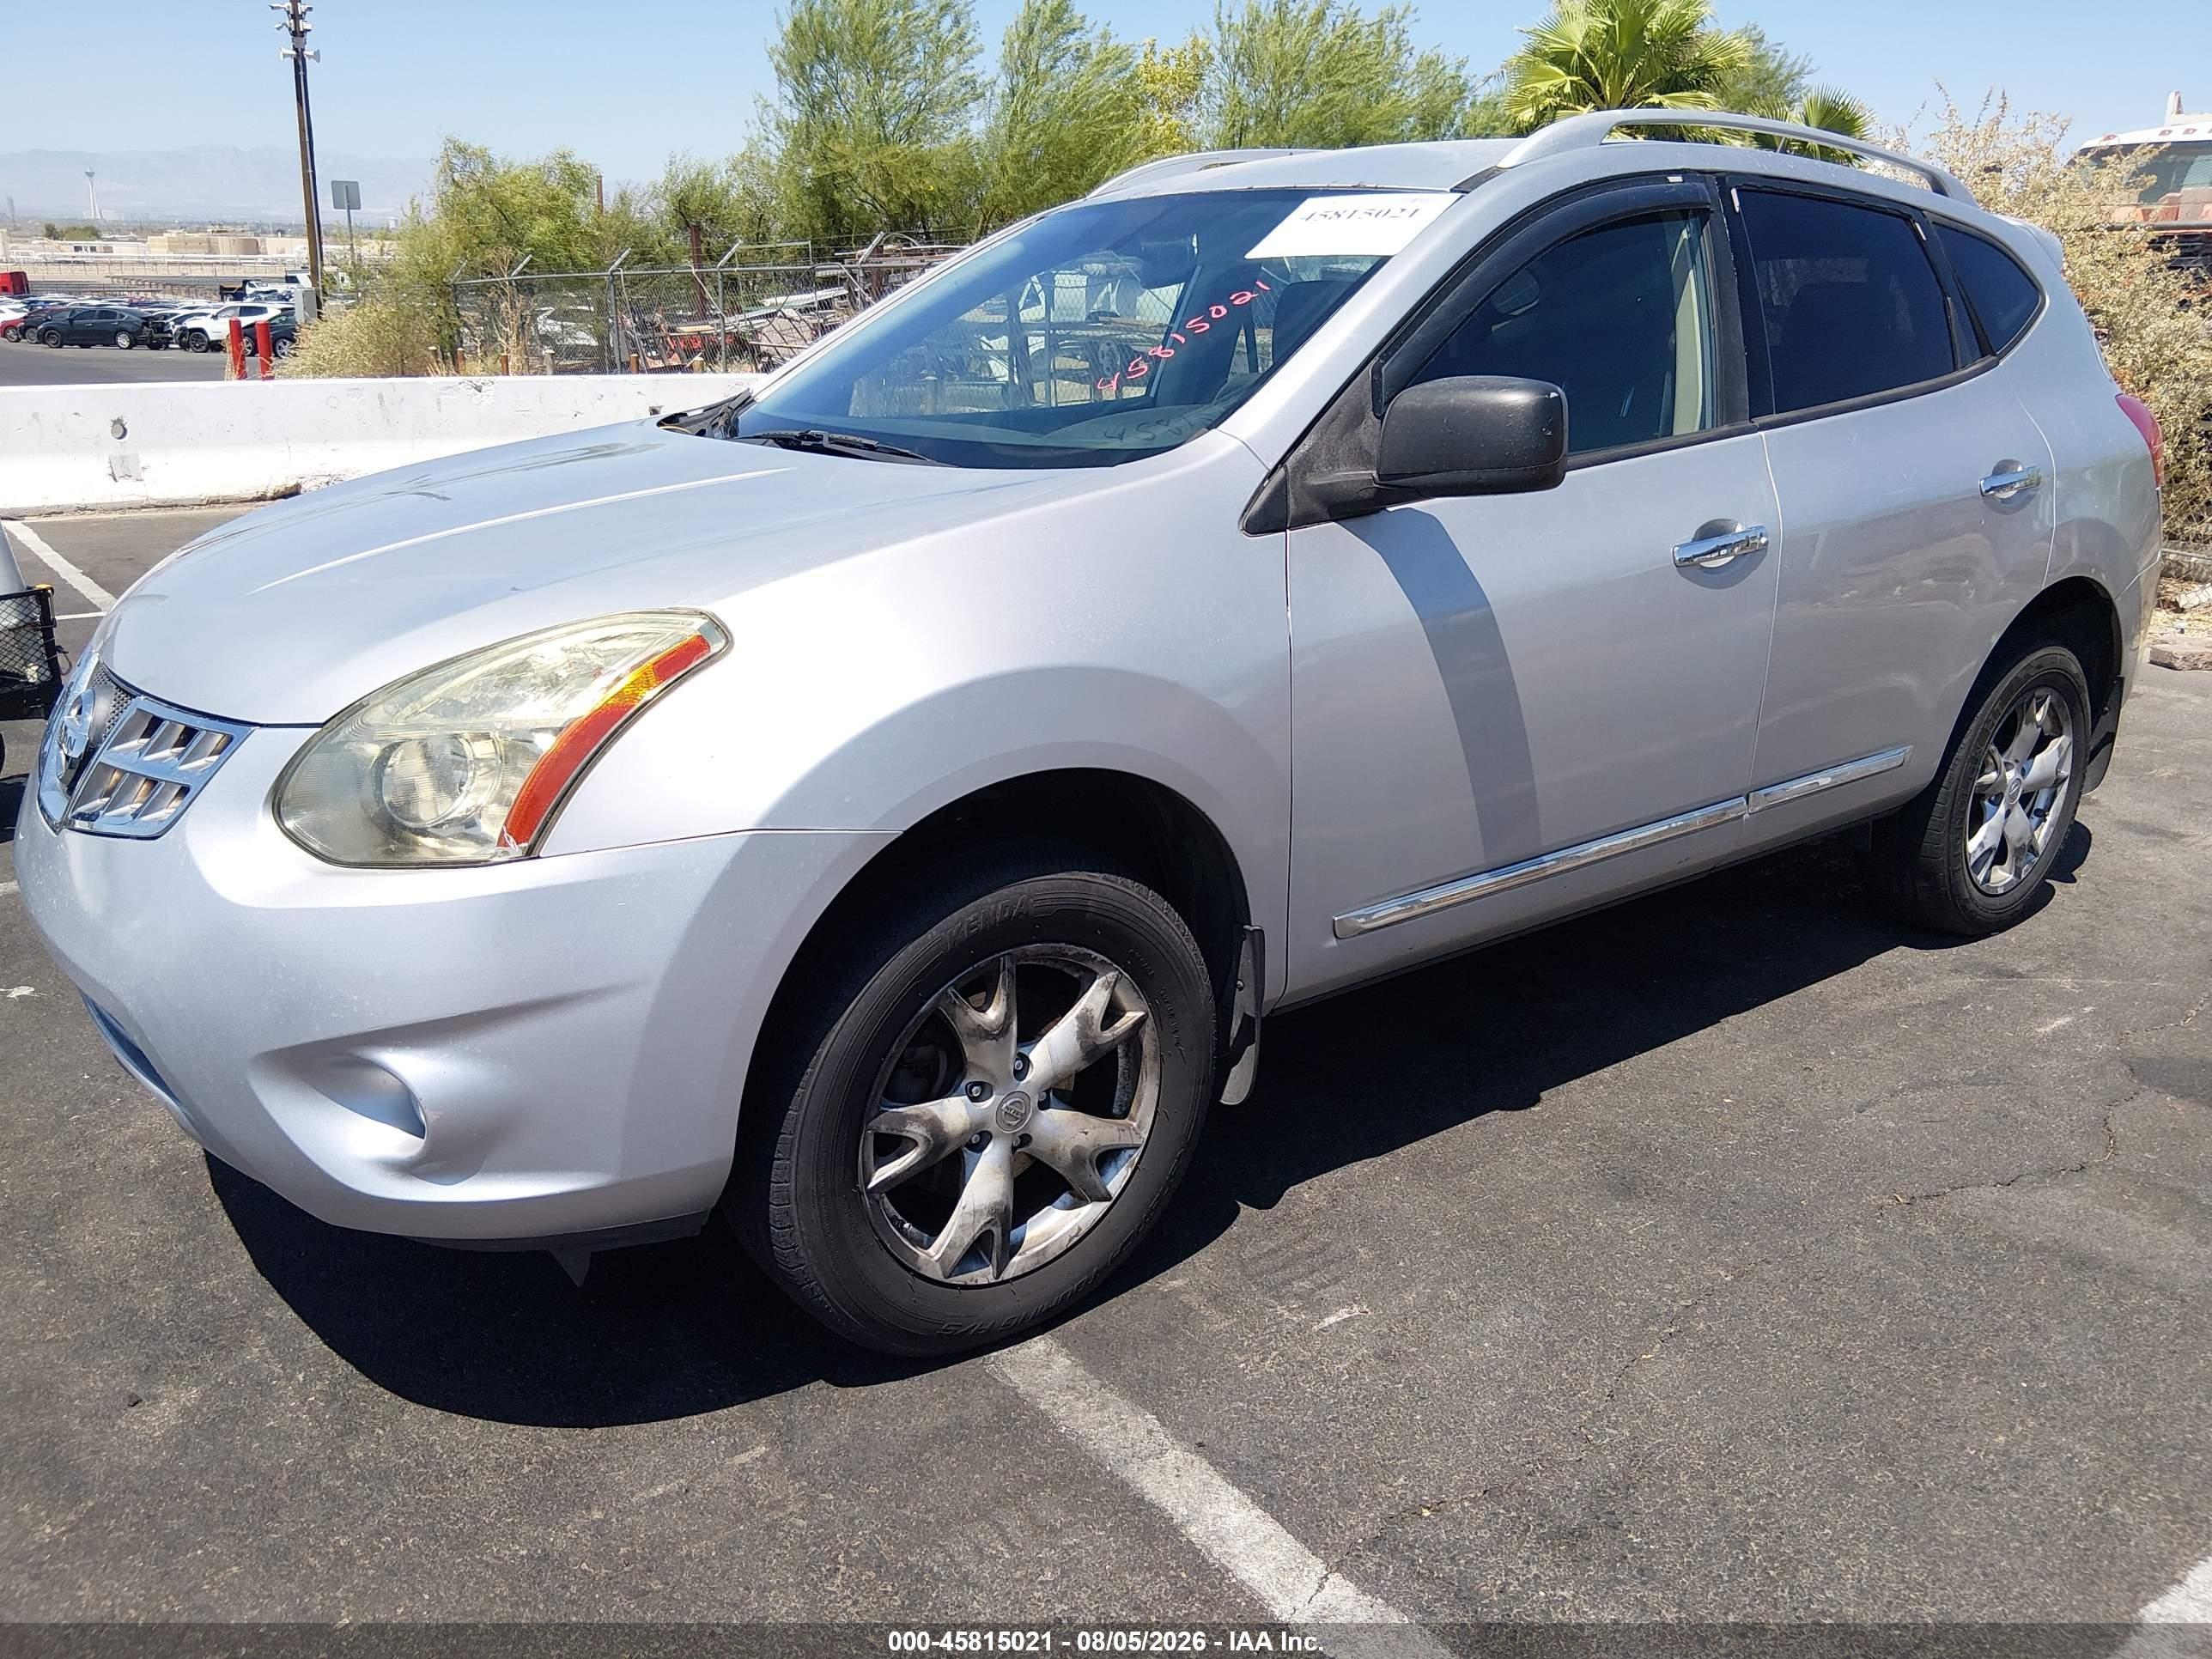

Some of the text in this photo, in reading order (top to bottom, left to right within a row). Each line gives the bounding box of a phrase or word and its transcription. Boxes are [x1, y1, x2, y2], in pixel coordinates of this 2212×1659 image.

[1300, 207, 1422, 222] 45815021
[1097, 279, 1272, 392] 45815021
[945, 894, 1028, 951] KENDA
